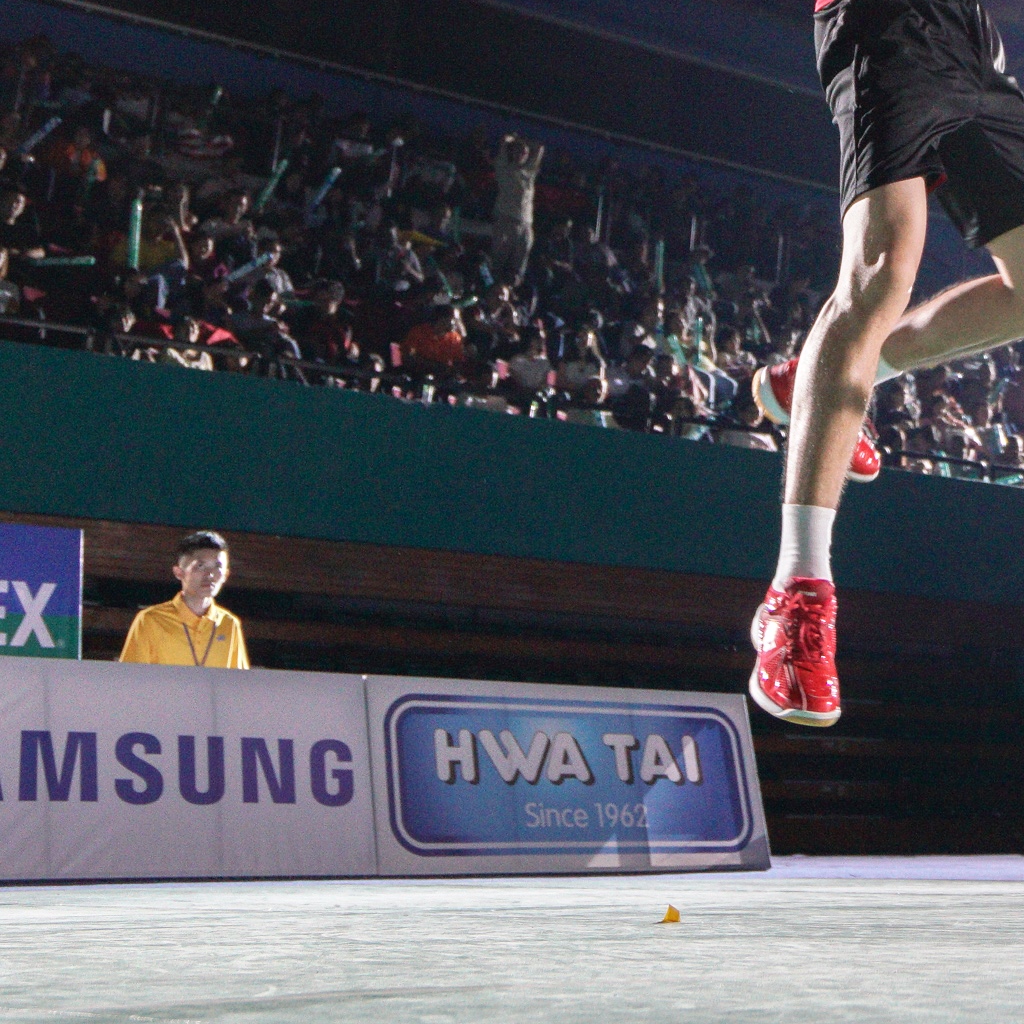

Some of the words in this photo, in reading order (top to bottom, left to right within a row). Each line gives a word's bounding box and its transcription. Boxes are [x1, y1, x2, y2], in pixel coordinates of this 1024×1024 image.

[0, 579, 57, 648] X
[0, 729, 355, 807] MSUNG
[434, 727, 595, 785] HWA
[603, 732, 702, 785] TAI
[524, 802, 588, 827] Since
[594, 802, 649, 827] 1962
